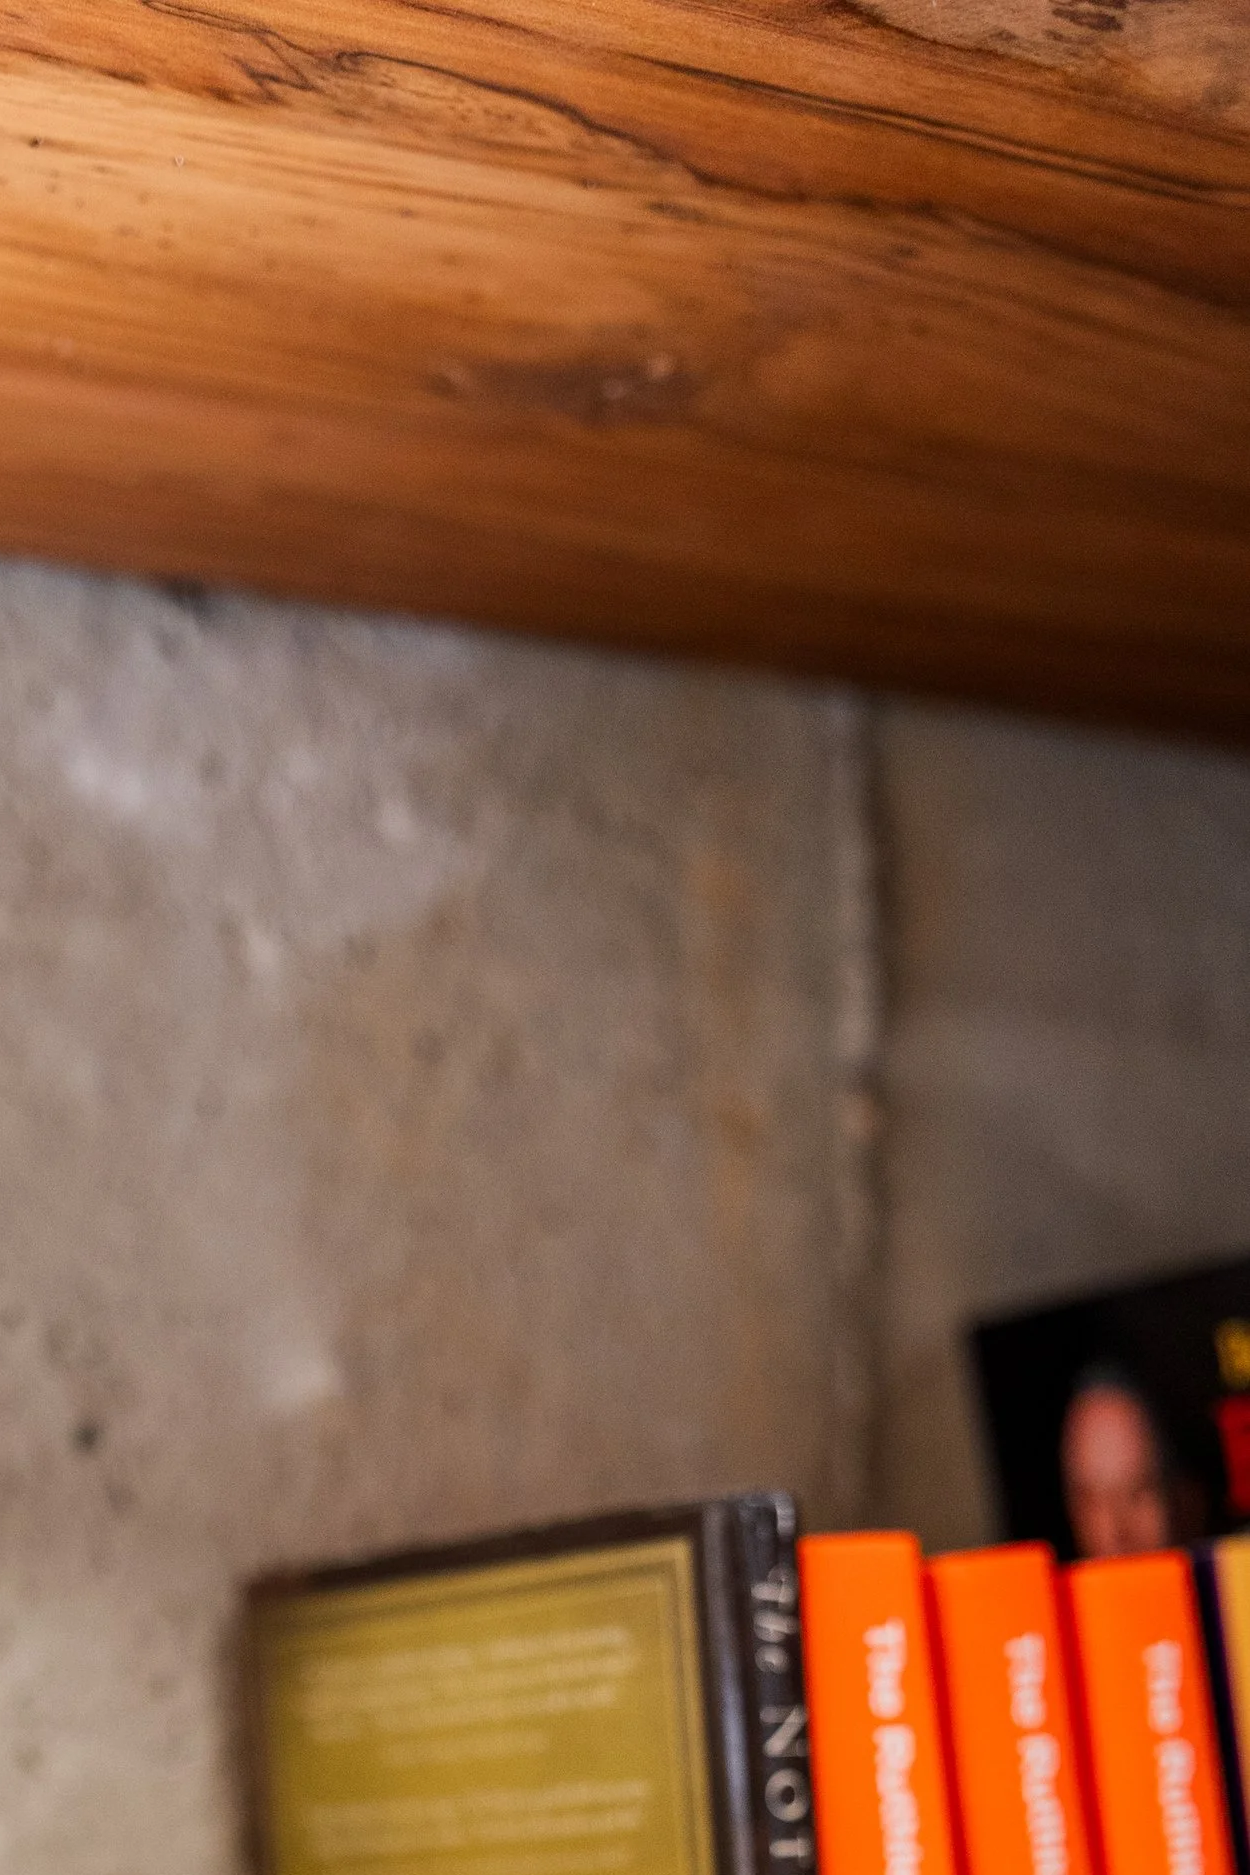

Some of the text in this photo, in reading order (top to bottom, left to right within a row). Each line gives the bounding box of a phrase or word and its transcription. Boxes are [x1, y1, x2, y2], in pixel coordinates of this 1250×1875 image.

[864, 1618, 908, 1718] The
[1004, 1630, 1047, 1729] The
[1144, 1639, 1183, 1734] The
